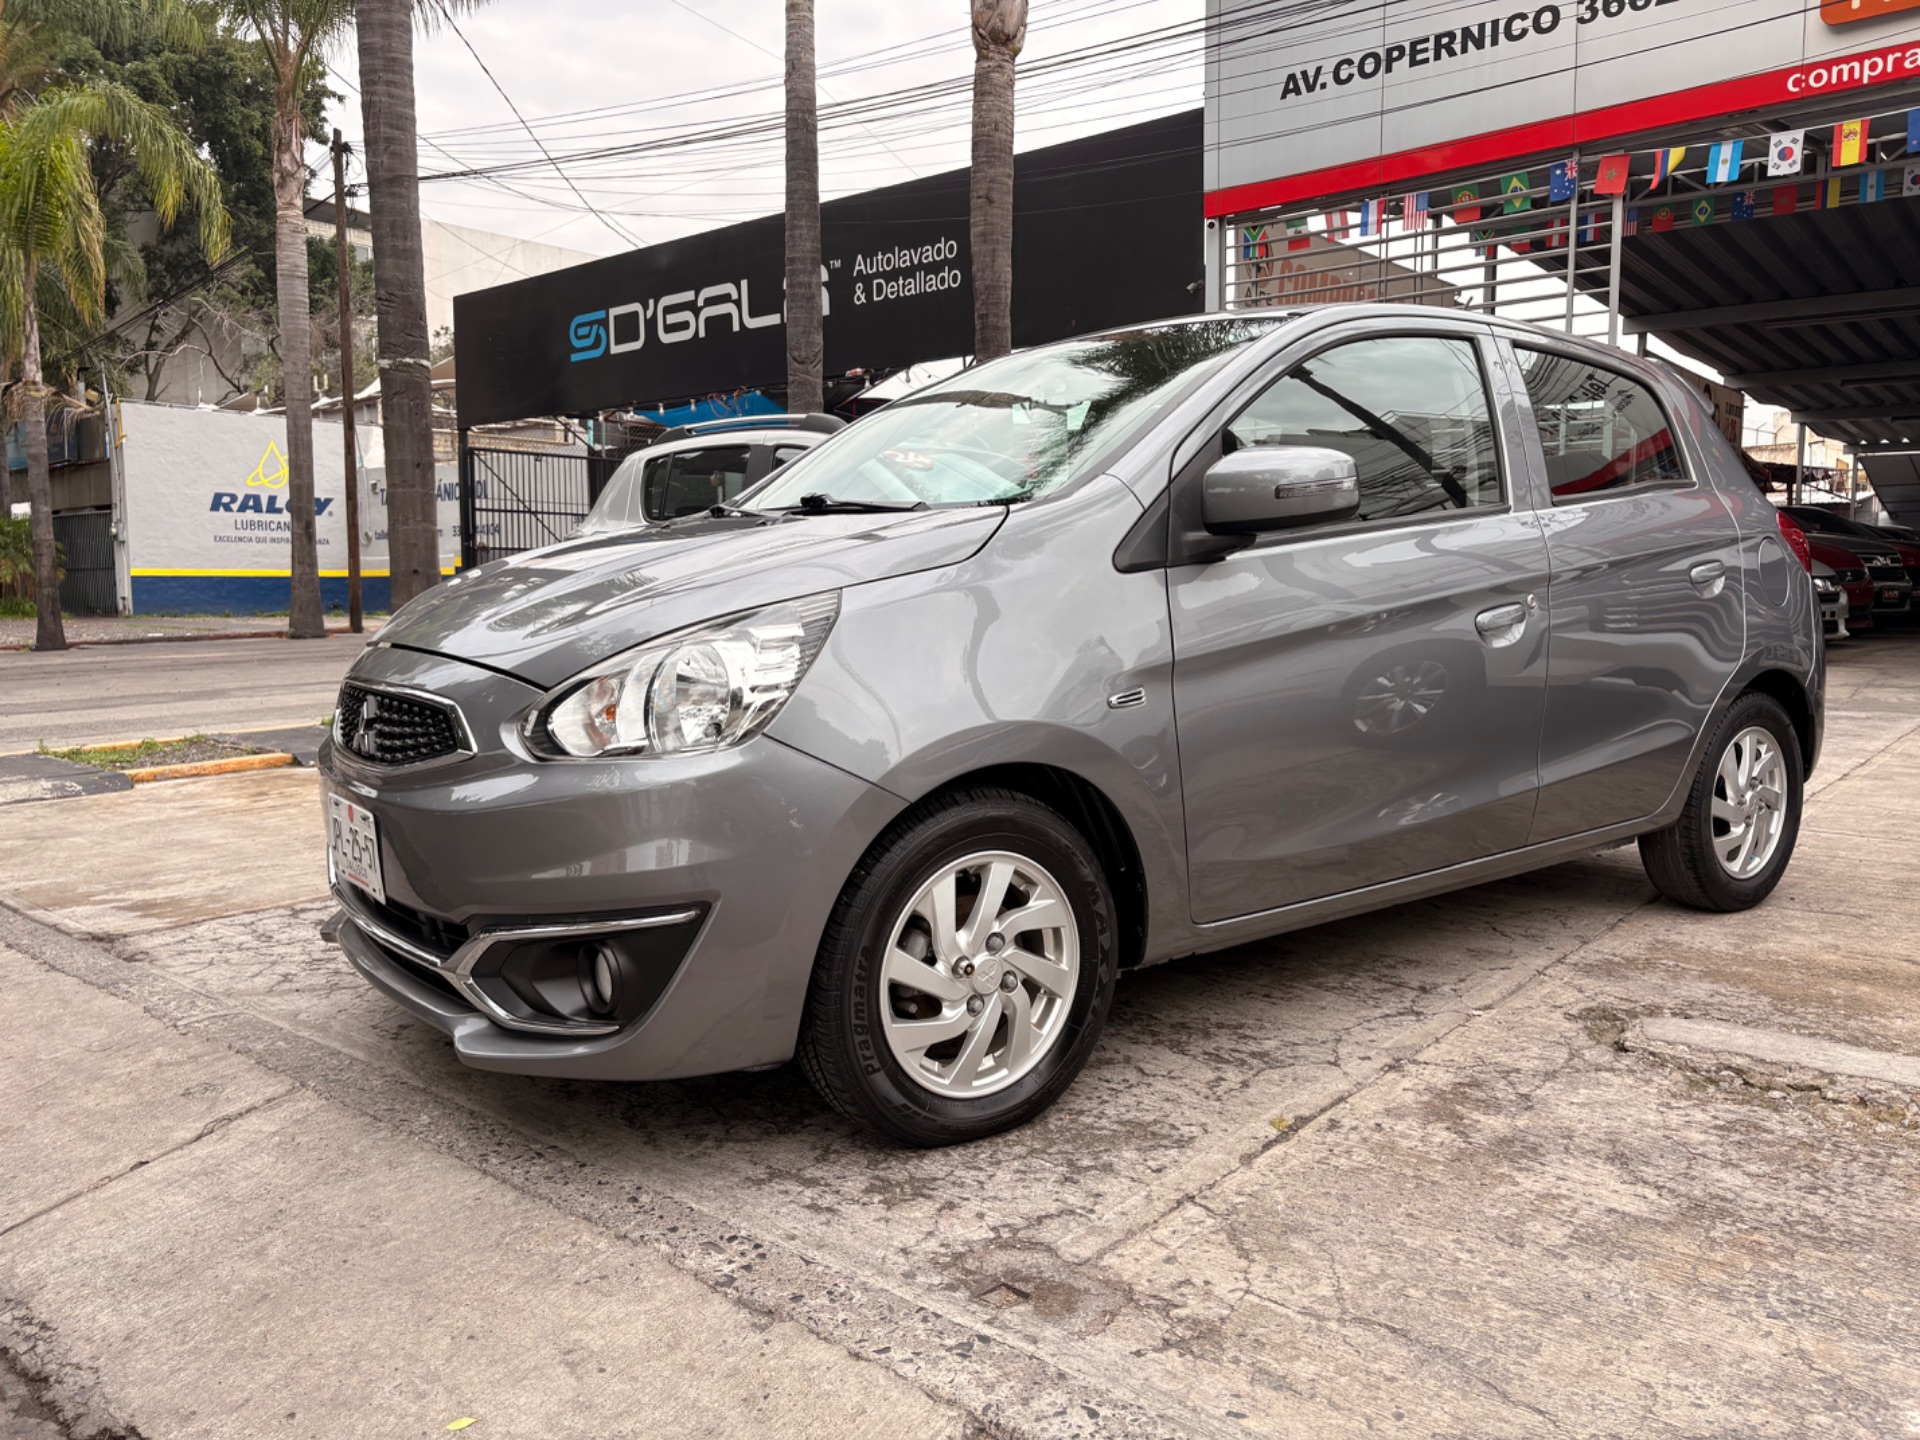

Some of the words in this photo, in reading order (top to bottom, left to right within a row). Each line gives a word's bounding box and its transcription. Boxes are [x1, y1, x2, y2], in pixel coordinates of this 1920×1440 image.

[853, 236, 958, 277] Autolavado
[853, 282, 867, 305] &
[873, 266, 962, 302] Detallado
[608, 264, 830, 355] D'GAL
[209, 492, 335, 516] RALY
[213, 535, 253, 544] EXCELENCIA
[255, 536, 268, 544] QUE
